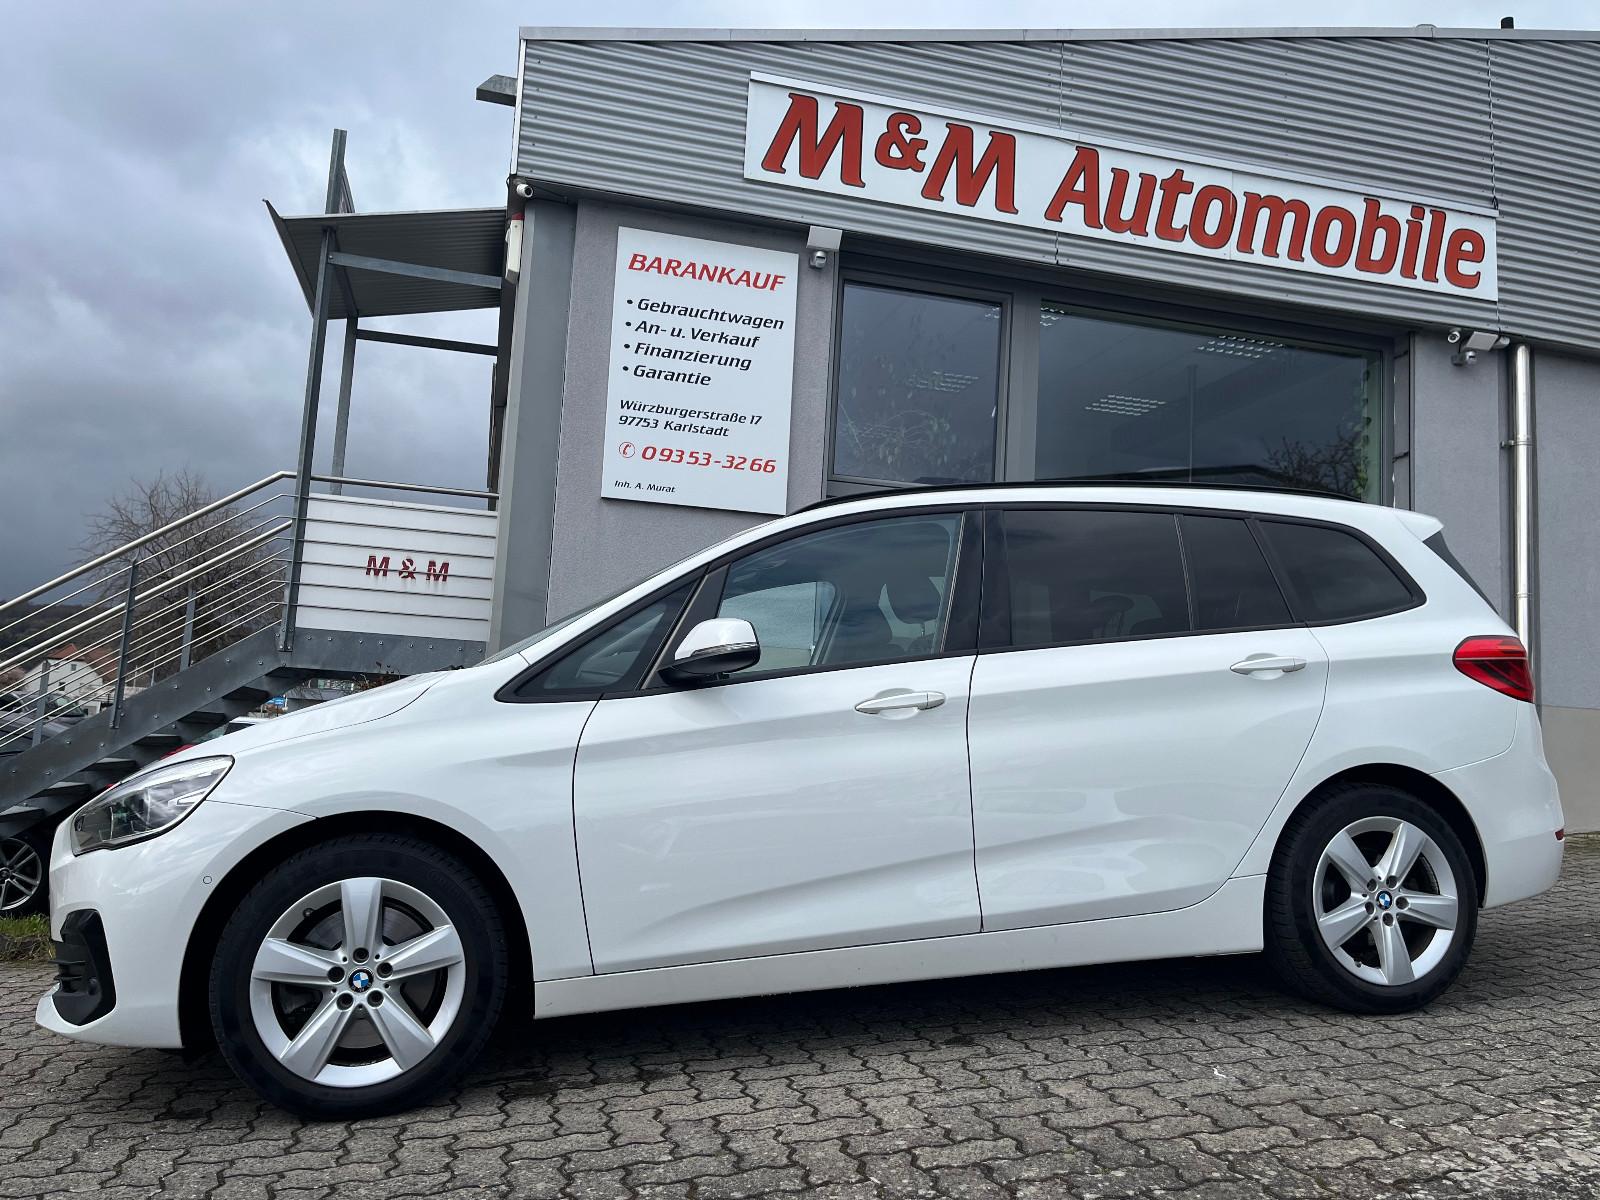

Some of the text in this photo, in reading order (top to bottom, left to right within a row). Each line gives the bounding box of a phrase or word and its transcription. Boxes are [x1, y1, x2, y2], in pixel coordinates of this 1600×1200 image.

[761, 93, 1486, 289] M&M Automobile
[628, 253, 786, 291] BARANKAUF
[637, 298, 785, 330] Gebrauchtwagen
[635, 320, 760, 348] An- u. Verkauf
[634, 342, 752, 371] Finanzierung
[633, 365, 711, 386] Garantie
[618, 415, 730, 437] 97753 Karlstadt
[620, 400, 762, 425] Würzburgerstraße 17
[614, 480, 676, 493] Inh. A. Murat
[366, 555, 450, 582] M & M
